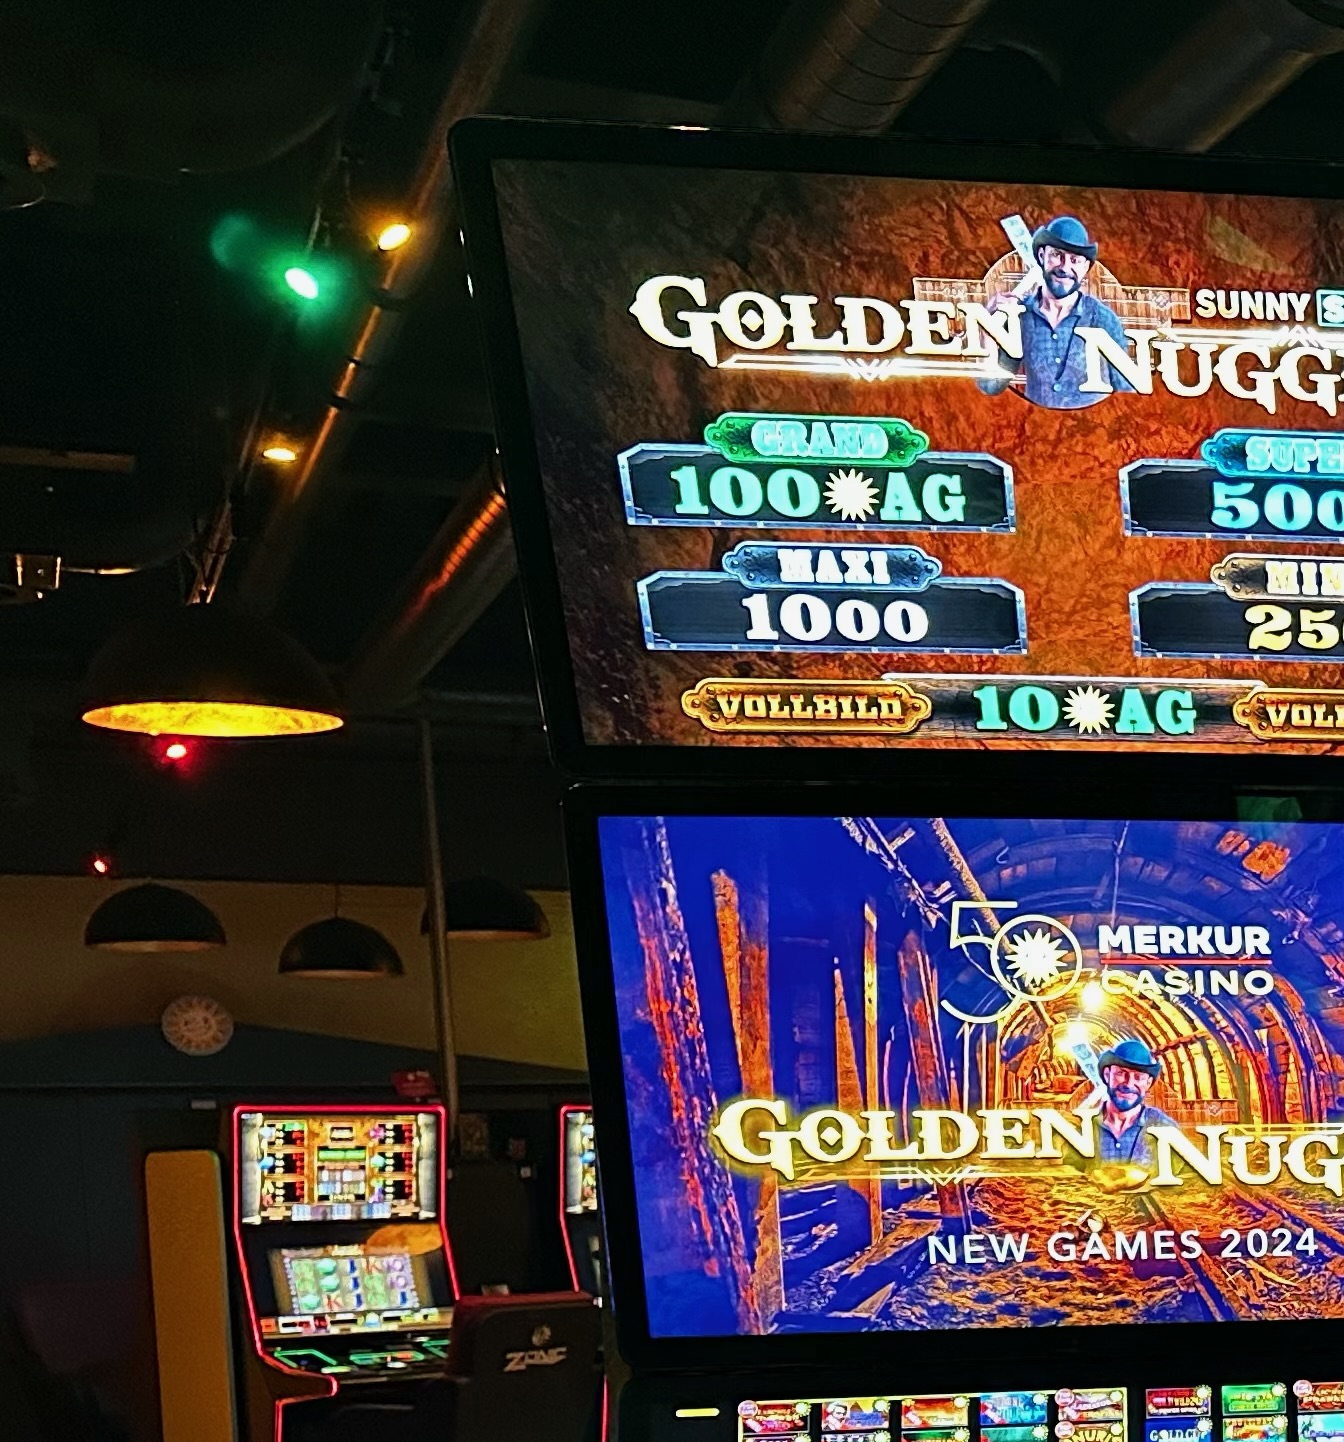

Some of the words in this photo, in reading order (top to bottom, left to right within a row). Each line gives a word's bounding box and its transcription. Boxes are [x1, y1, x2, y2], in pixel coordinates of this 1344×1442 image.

[628, 275, 1026, 368] GOLDEN
[1196, 289, 1311, 322] SUNNY
[750, 419, 889, 460] GRAND
[777, 549, 890, 585] MAXI
[742, 594, 930, 643] 1000
[716, 694, 904, 721] VOLLBILD
[973, 685, 1063, 731] 10
[1098, 925, 1272, 955] MERKUR
[1100, 970, 1275, 997] CASINO
[713, 1098, 1099, 1182] GOLDEN
[928, 1232, 1029, 1265] NEW
[1047, 1229, 1202, 1262] GAMES
[1221, 1227, 1318, 1258] 2024
